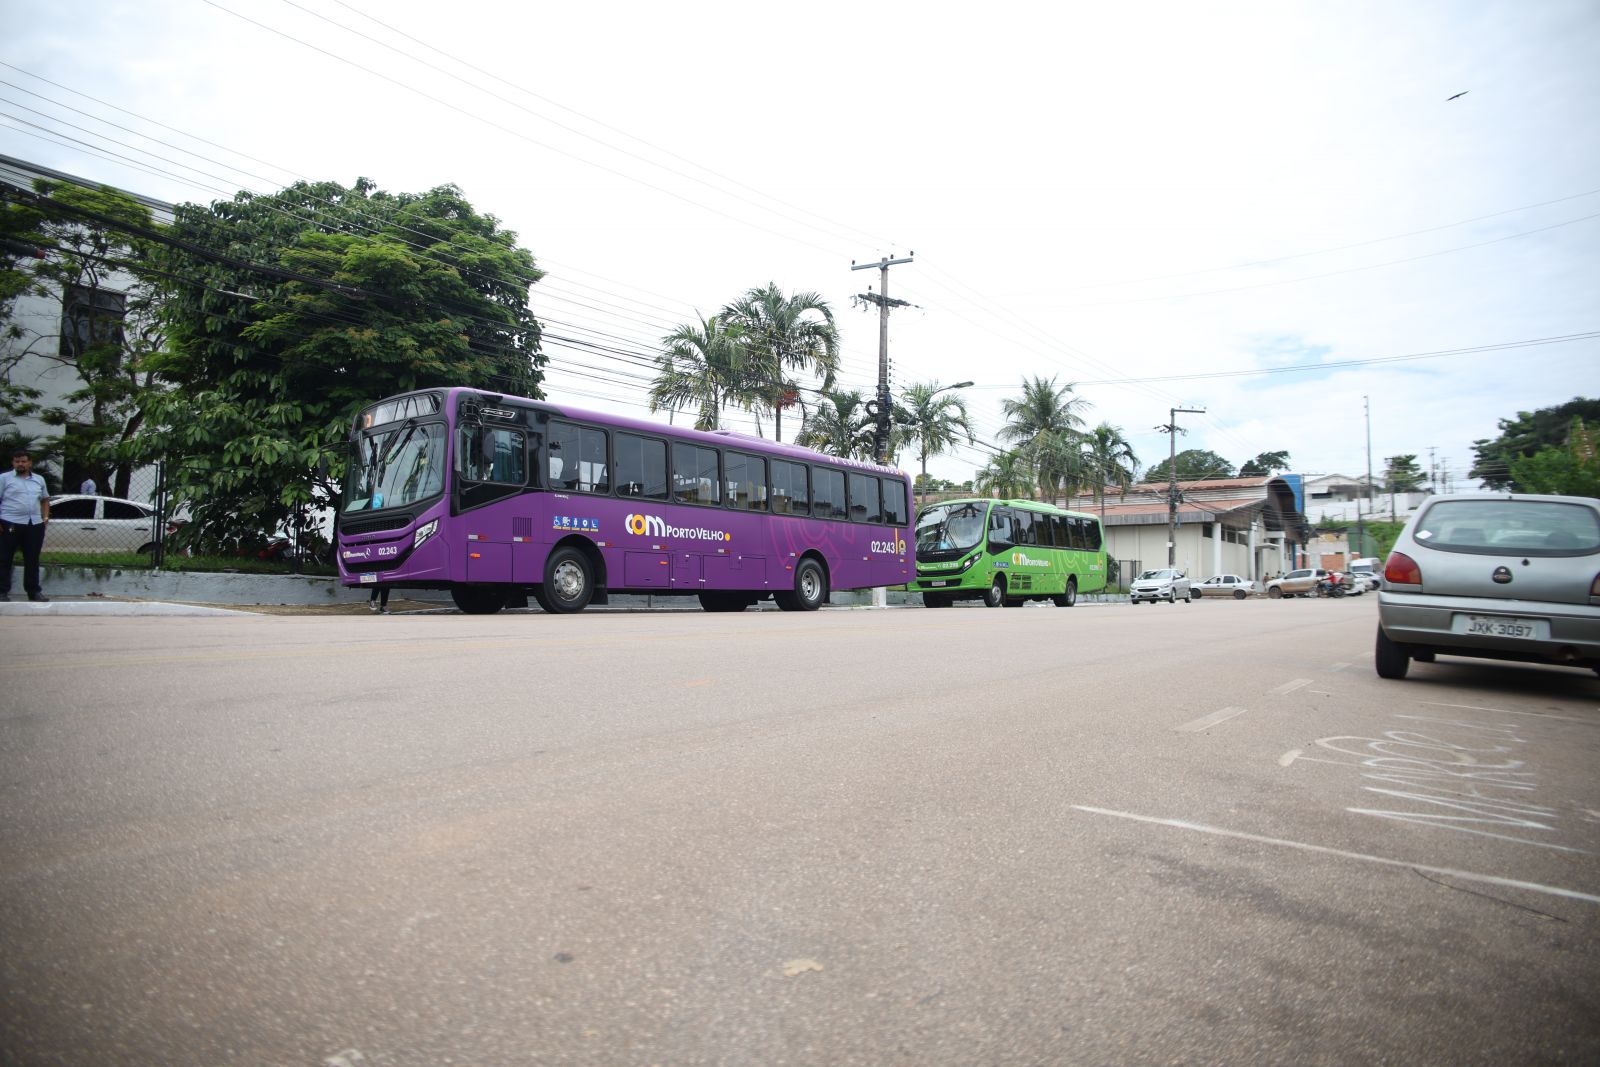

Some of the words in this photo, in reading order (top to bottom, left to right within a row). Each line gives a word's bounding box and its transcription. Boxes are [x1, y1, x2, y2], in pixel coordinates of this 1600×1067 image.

[378, 546, 398, 556] 02.243
[871, 540, 896, 554] 02.243
[1468, 621, 1533, 637] JXK-3097
